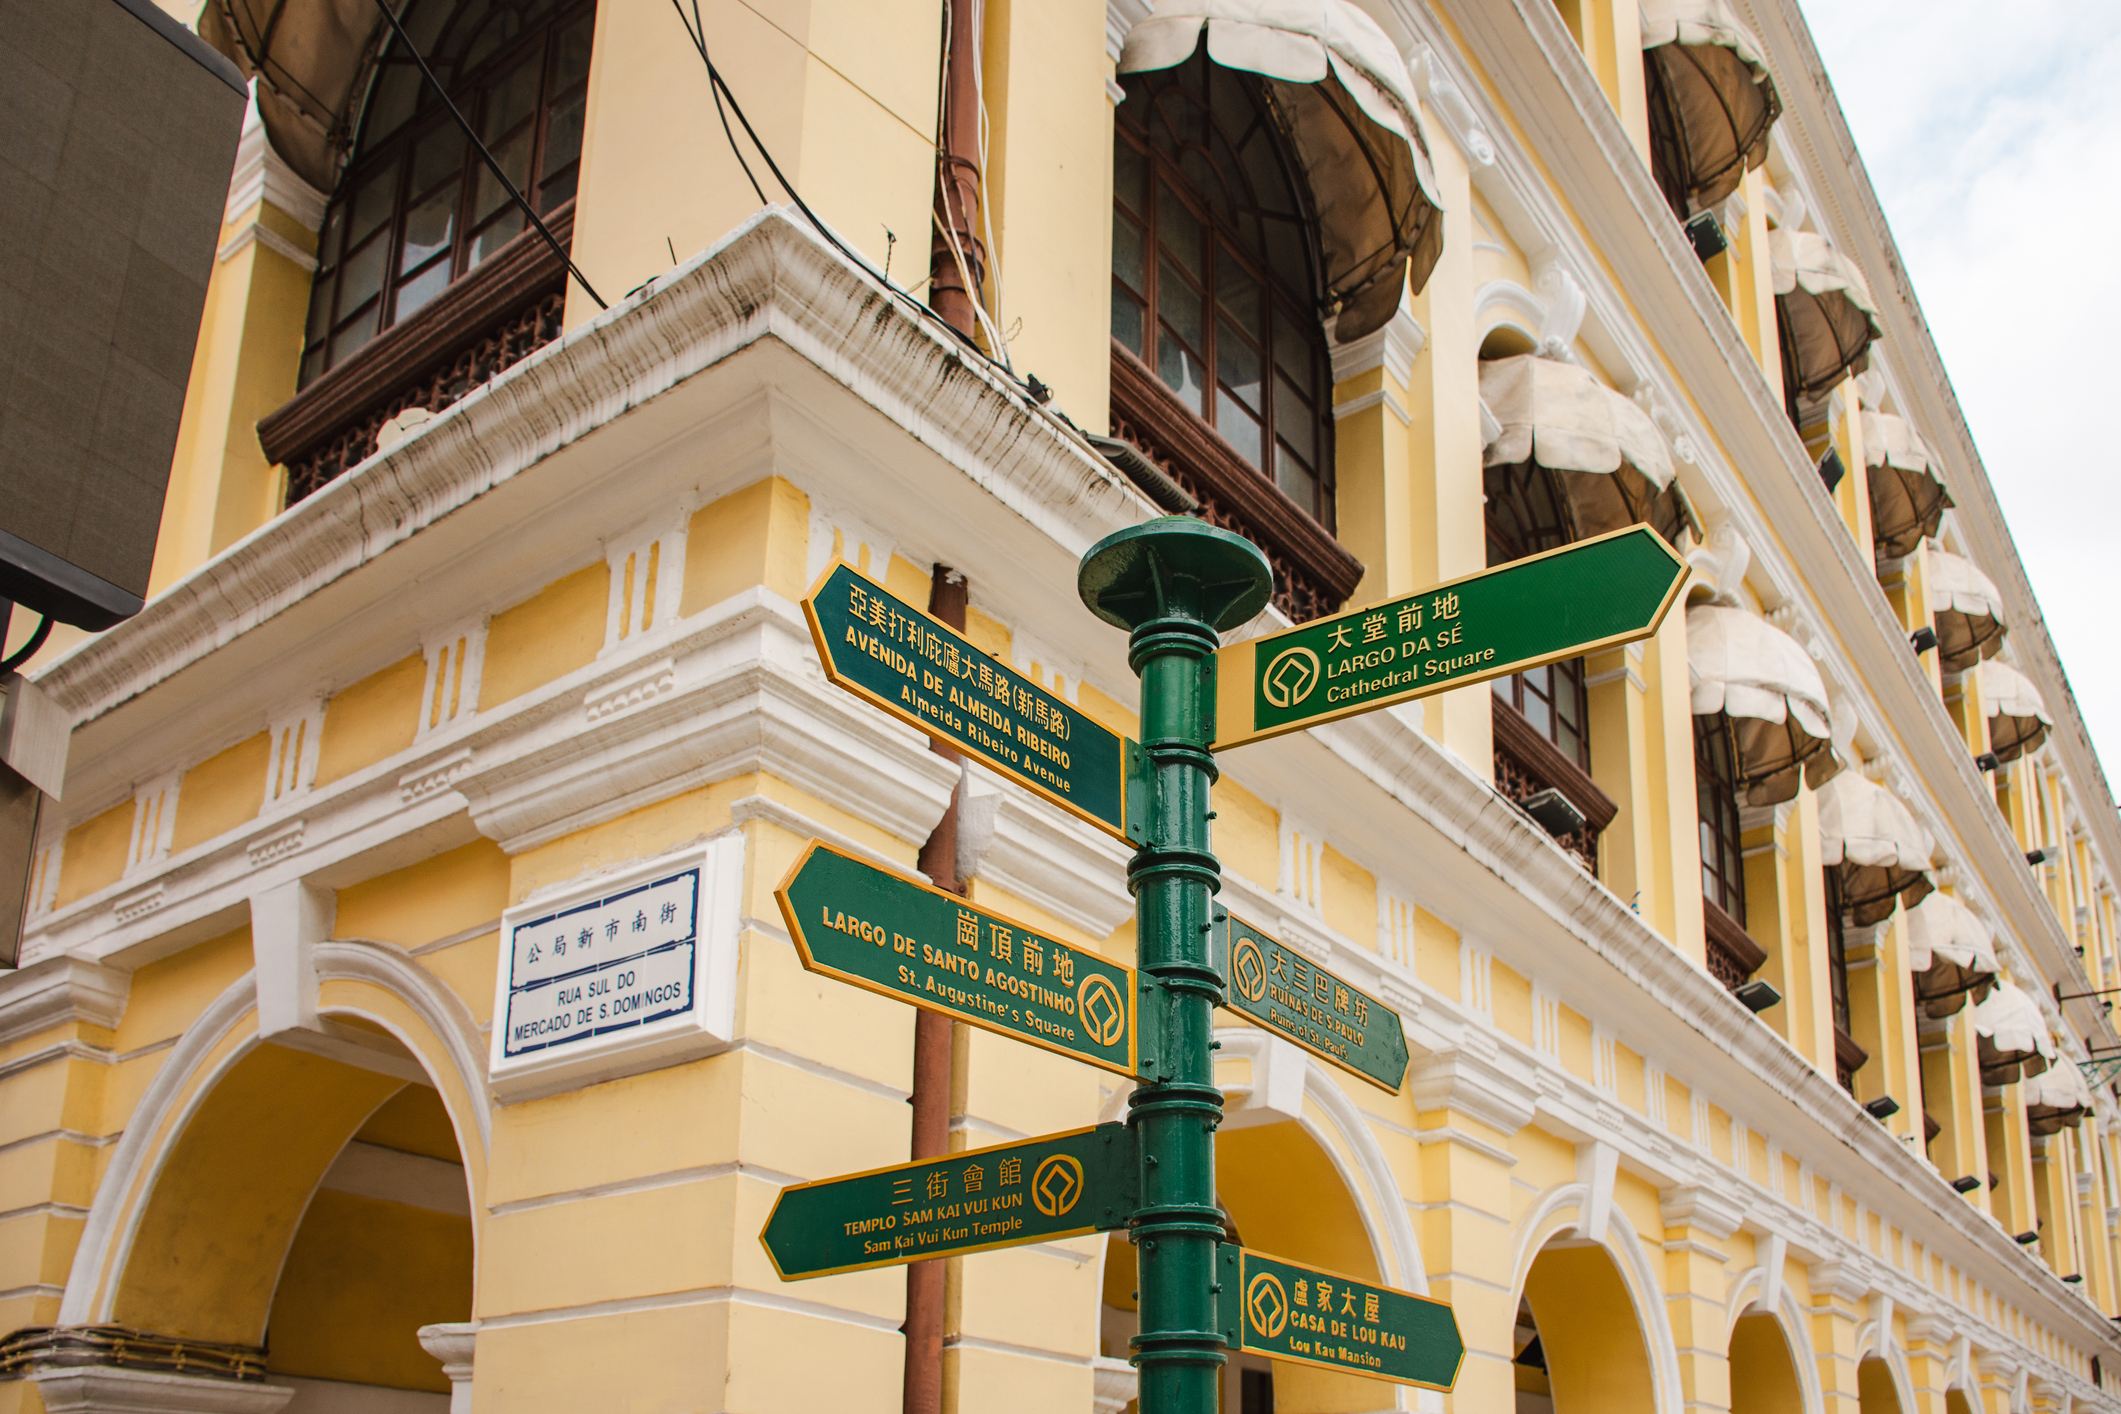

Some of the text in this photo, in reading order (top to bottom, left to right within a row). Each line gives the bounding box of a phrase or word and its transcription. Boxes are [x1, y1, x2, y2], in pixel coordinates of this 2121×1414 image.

[1327, 592, 1460, 653] 大堂前地
[1327, 622, 1463, 680] LARGO DA SÉ
[845, 625, 1071, 770] AVENIDA DE ALMEIDA RIBEIRO
[1326, 647, 1495, 703] Cathedral Square
[901, 685, 1071, 793] Almeida Ribeiro Avenue
[526, 901, 678, 965] 公局新市南街
[822, 906, 1075, 1016] LARGO DE SANTO AGOSTINHO
[956, 908, 1075, 988] 崗頂前地
[514, 981, 681, 1042] MERCADO DE S. DOMINGOS
[558, 970, 635, 1007] RUA SUL DO
[898, 965, 921, 989] St.
[1025, 1010, 1075, 1041] Square
[1270, 949, 1369, 1027] 大三巴牌坊
[1270, 984, 1308, 1017] RUÍNAS
[1310, 1006, 1324, 1025] DE
[1270, 1008, 1348, 1060] Ruins of St. Paul's
[891, 1157, 1022, 1206] 三街會館
[844, 1193, 1023, 1237] TEMPLO SAM KAI VUI KUN
[864, 1217, 1023, 1255] Sam Kai Vui Kun Temple
[1293, 1278, 1380, 1324] 盧家大屋
[1289, 1336, 1381, 1368] Lou Kau Mansion
[1290, 1310, 1406, 1351] CASA DE LOU KAU
